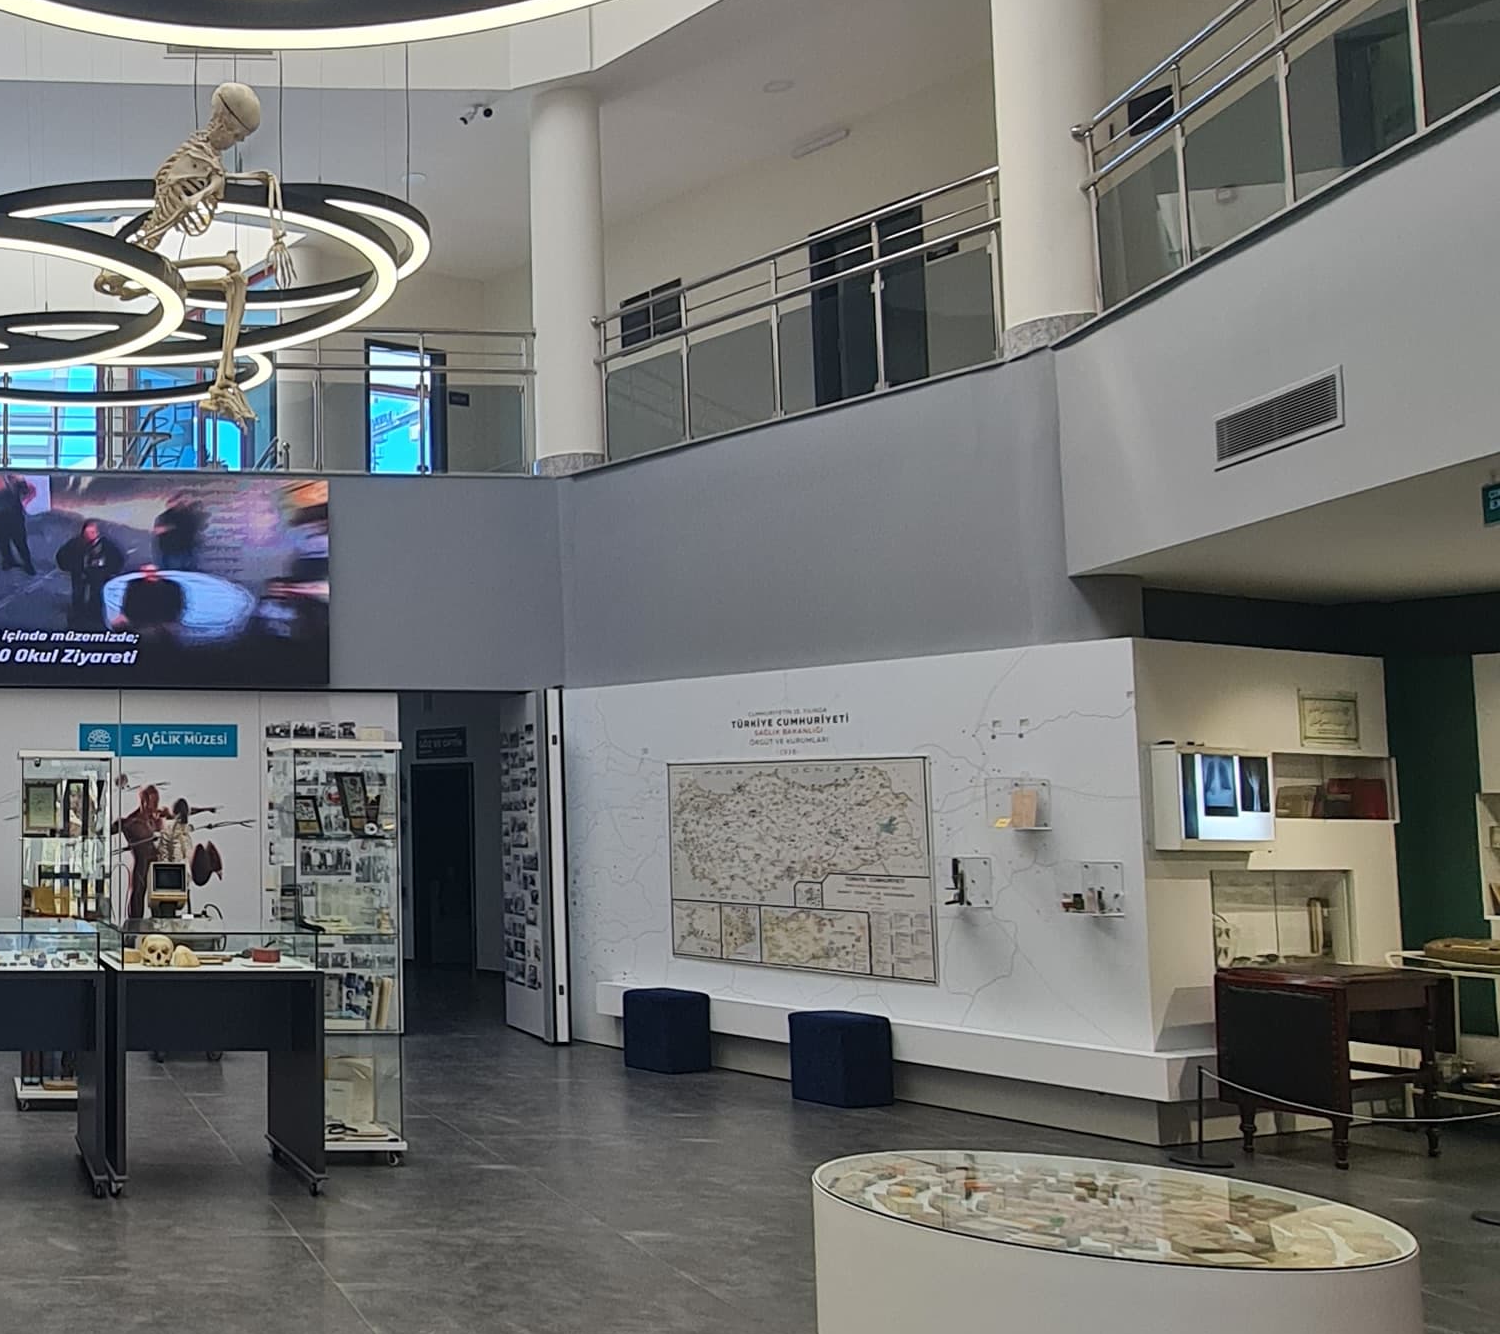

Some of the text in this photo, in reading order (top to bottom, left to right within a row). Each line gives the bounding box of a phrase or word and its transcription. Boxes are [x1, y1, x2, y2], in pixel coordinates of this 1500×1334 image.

[2, 630, 47, 644] içinde
[50, 630, 140, 644] müzemizde;
[15, 648, 59, 664] Okul
[61, 648, 138, 666] Ziyareti
[731, 712, 849, 729] TÜRKİYE CUMHURİYETİ
[754, 728, 780, 736] SAĞLIK
[132, 731, 227, 751] SAĞLIK MÜZESİ
